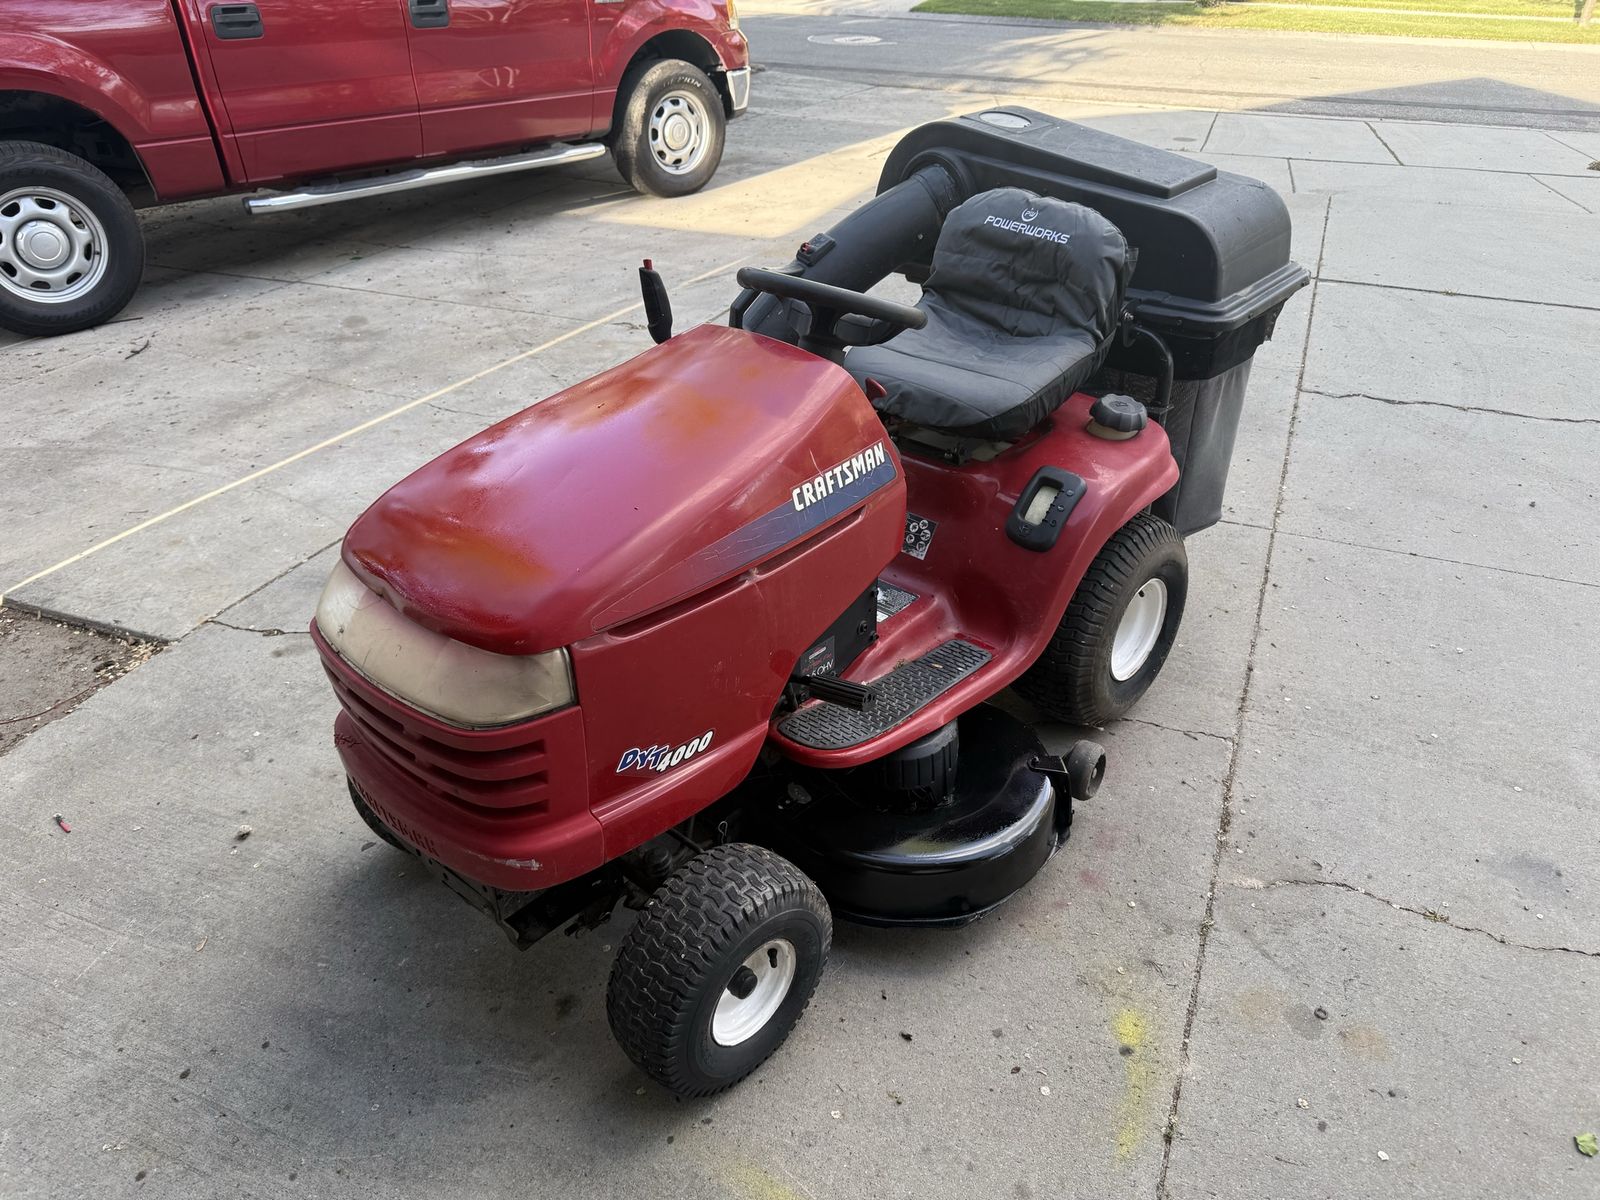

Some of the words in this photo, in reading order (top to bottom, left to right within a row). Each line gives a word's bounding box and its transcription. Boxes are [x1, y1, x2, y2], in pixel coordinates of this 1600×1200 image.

[984, 215, 1071, 244] POWERWORKS
[792, 441, 885, 512] CRAFTSMAN
[656, 730, 713, 772] 4000
